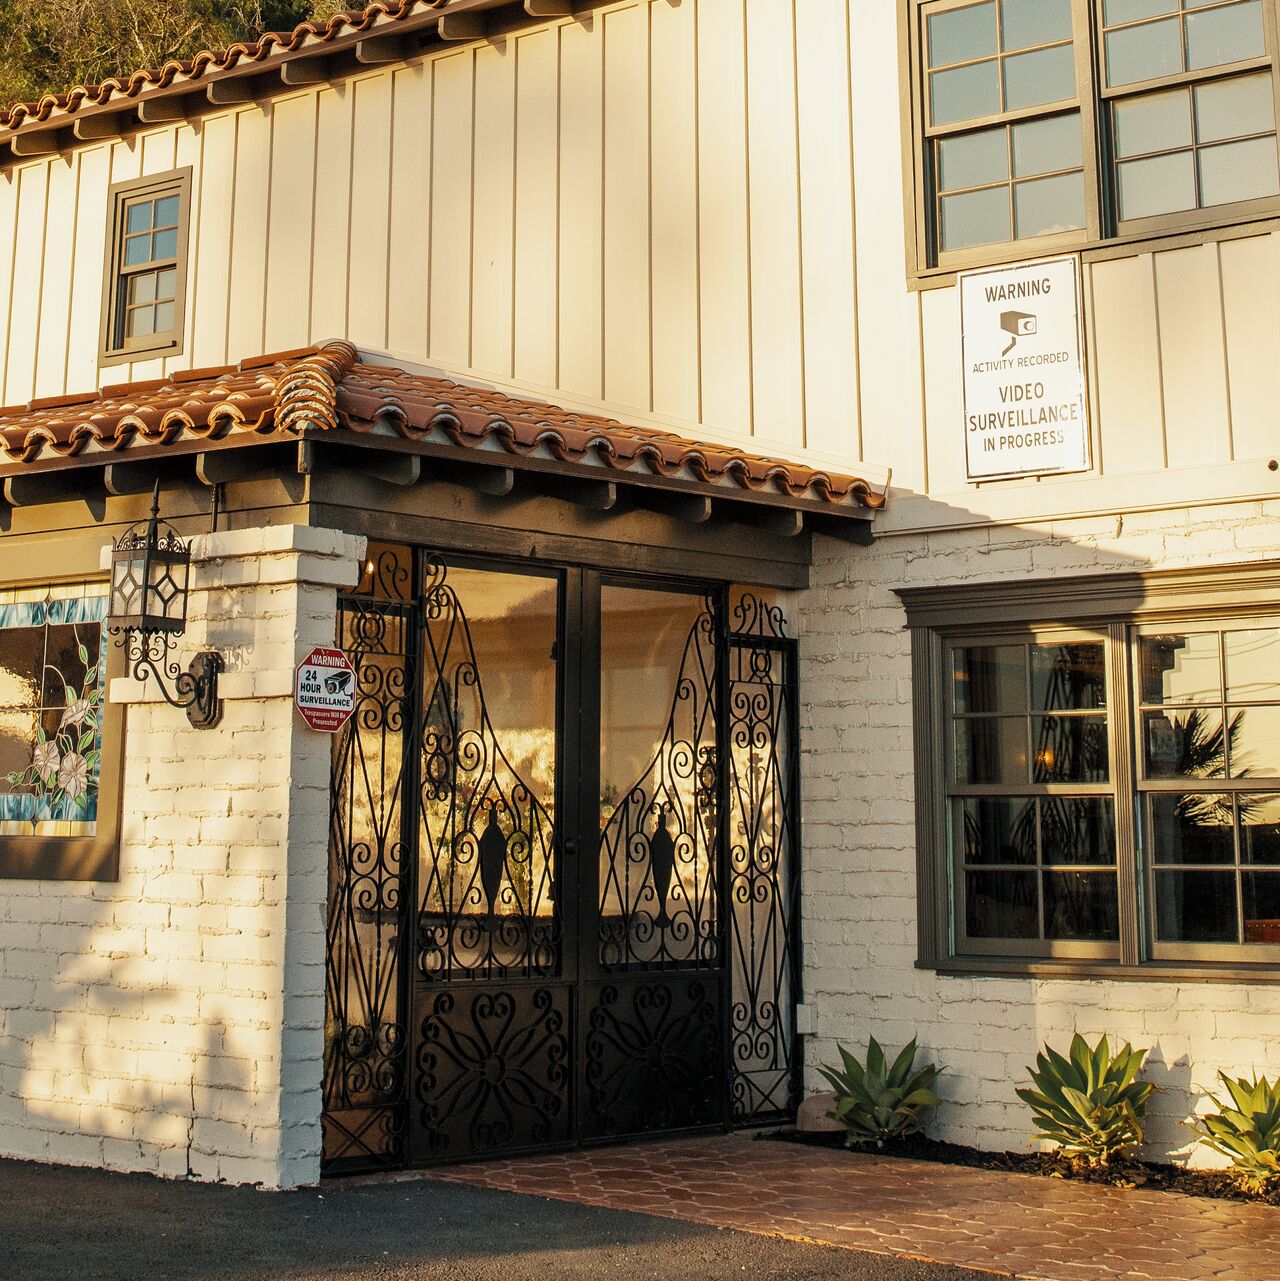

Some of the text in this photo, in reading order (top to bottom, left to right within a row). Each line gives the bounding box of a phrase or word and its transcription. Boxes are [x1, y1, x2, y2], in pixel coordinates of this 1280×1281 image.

[985, 278, 1051, 303] WARNING
[973, 352, 1069, 373] ACTIVITY RECORDED
[999, 382, 1044, 403] VIDEO
[969, 403, 1079, 432] SURVEILLANCE
[984, 430, 1064, 452] IN PROGRESS
[311, 655, 345, 667] WARNING
[305, 670, 317, 681] 24
[300, 682, 321, 694] HOUR
[300, 695, 350, 707] SURVEILLANCE
